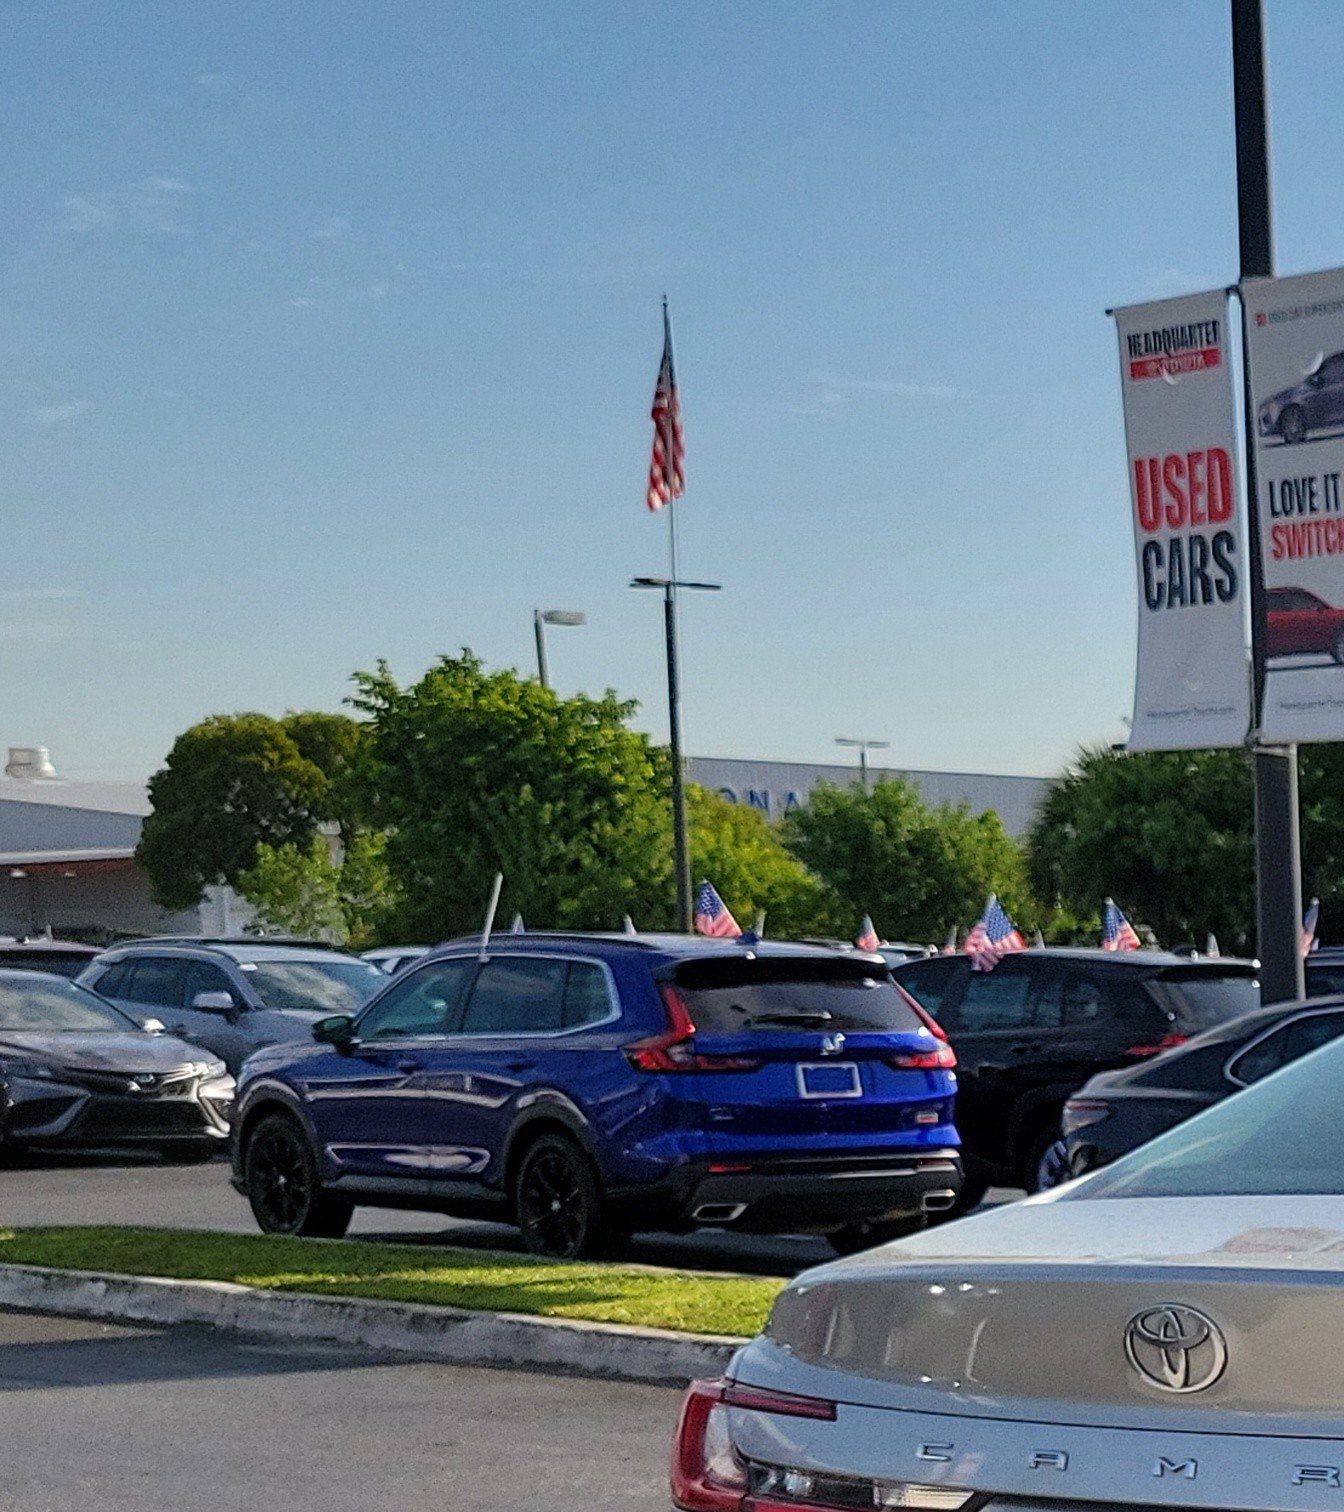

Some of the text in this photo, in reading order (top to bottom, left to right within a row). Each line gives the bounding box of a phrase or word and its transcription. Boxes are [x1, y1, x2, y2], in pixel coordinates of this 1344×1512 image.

[1127, 320, 1219, 359] HEADQUARTER
[1134, 447, 1233, 532] USED
[1268, 472, 1340, 519] LOVE IT
[1142, 530, 1238, 612] CARS
